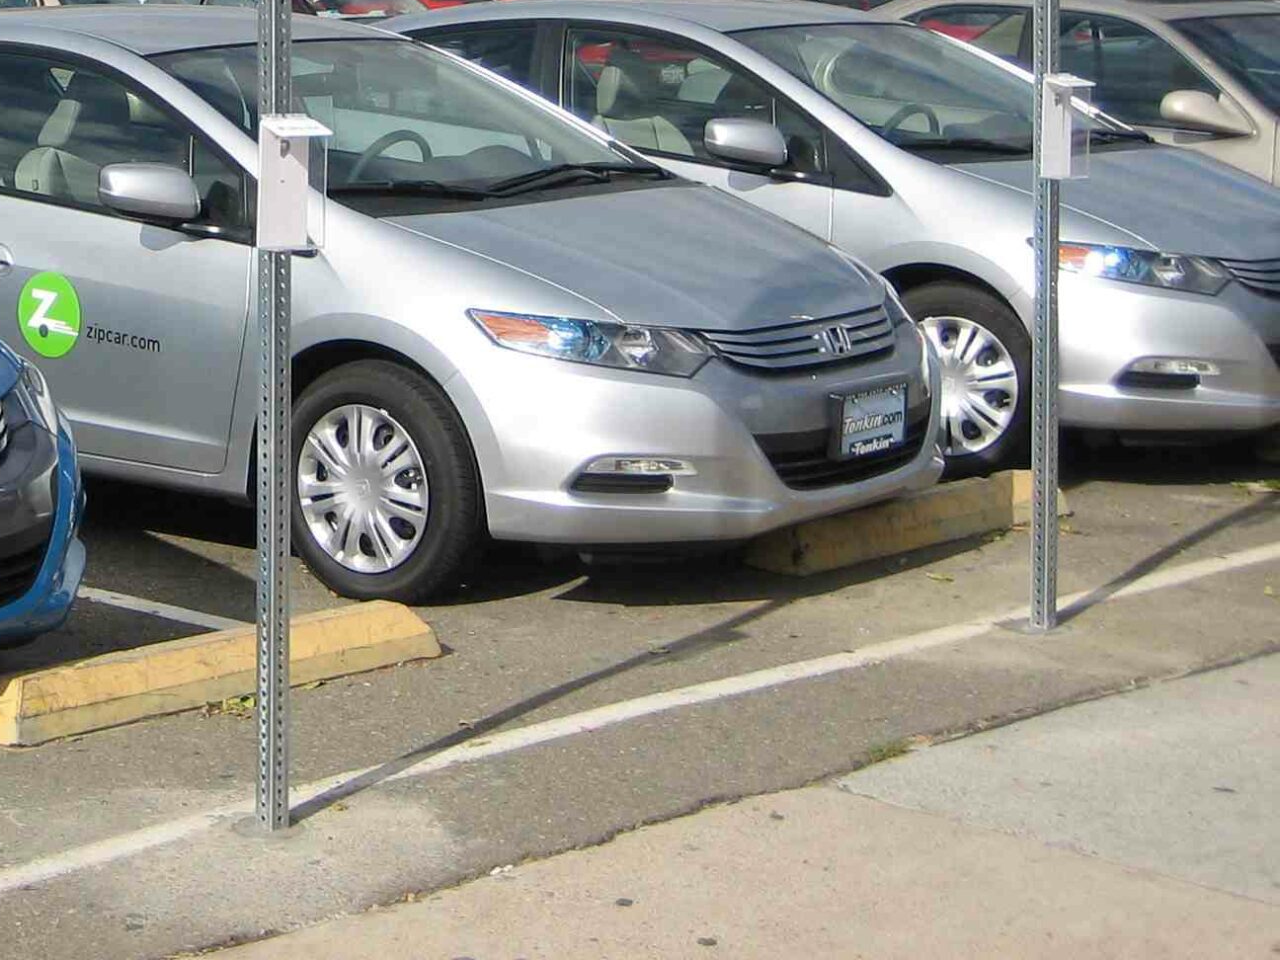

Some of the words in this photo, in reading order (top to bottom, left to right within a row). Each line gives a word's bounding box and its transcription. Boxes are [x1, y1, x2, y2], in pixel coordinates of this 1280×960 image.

[86, 323, 161, 352] zipcar.com
[843, 411, 902, 435] Tonkin.com
[854, 437, 890, 456] Tonkin
